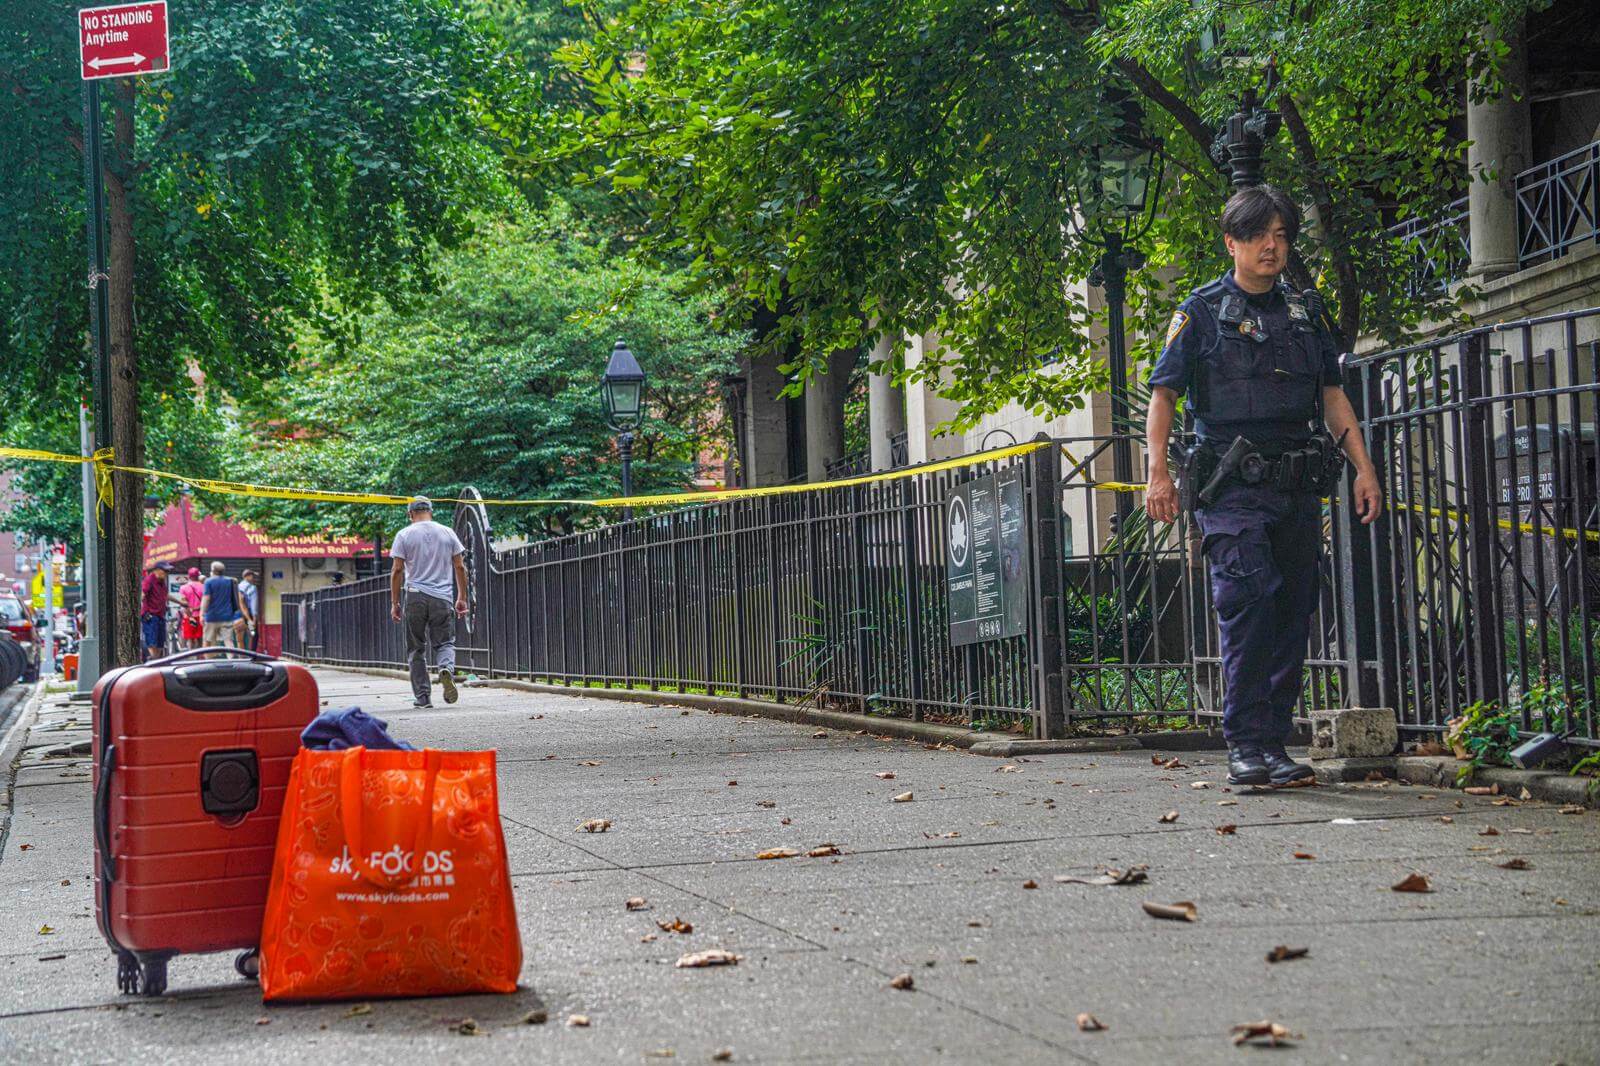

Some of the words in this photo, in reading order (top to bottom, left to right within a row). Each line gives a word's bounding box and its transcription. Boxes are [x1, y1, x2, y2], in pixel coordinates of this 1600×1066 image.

[84, 16, 99, 30] NO
[101, 10, 153, 28] STANDING
[86, 30, 129, 47] Anytime
[245, 534, 268, 544] YIN
[260, 545, 285, 554] Rice
[287, 545, 325, 554] Noodle
[327, 545, 349, 554] Roll
[336, 891, 450, 905] www.skyfoods.com
